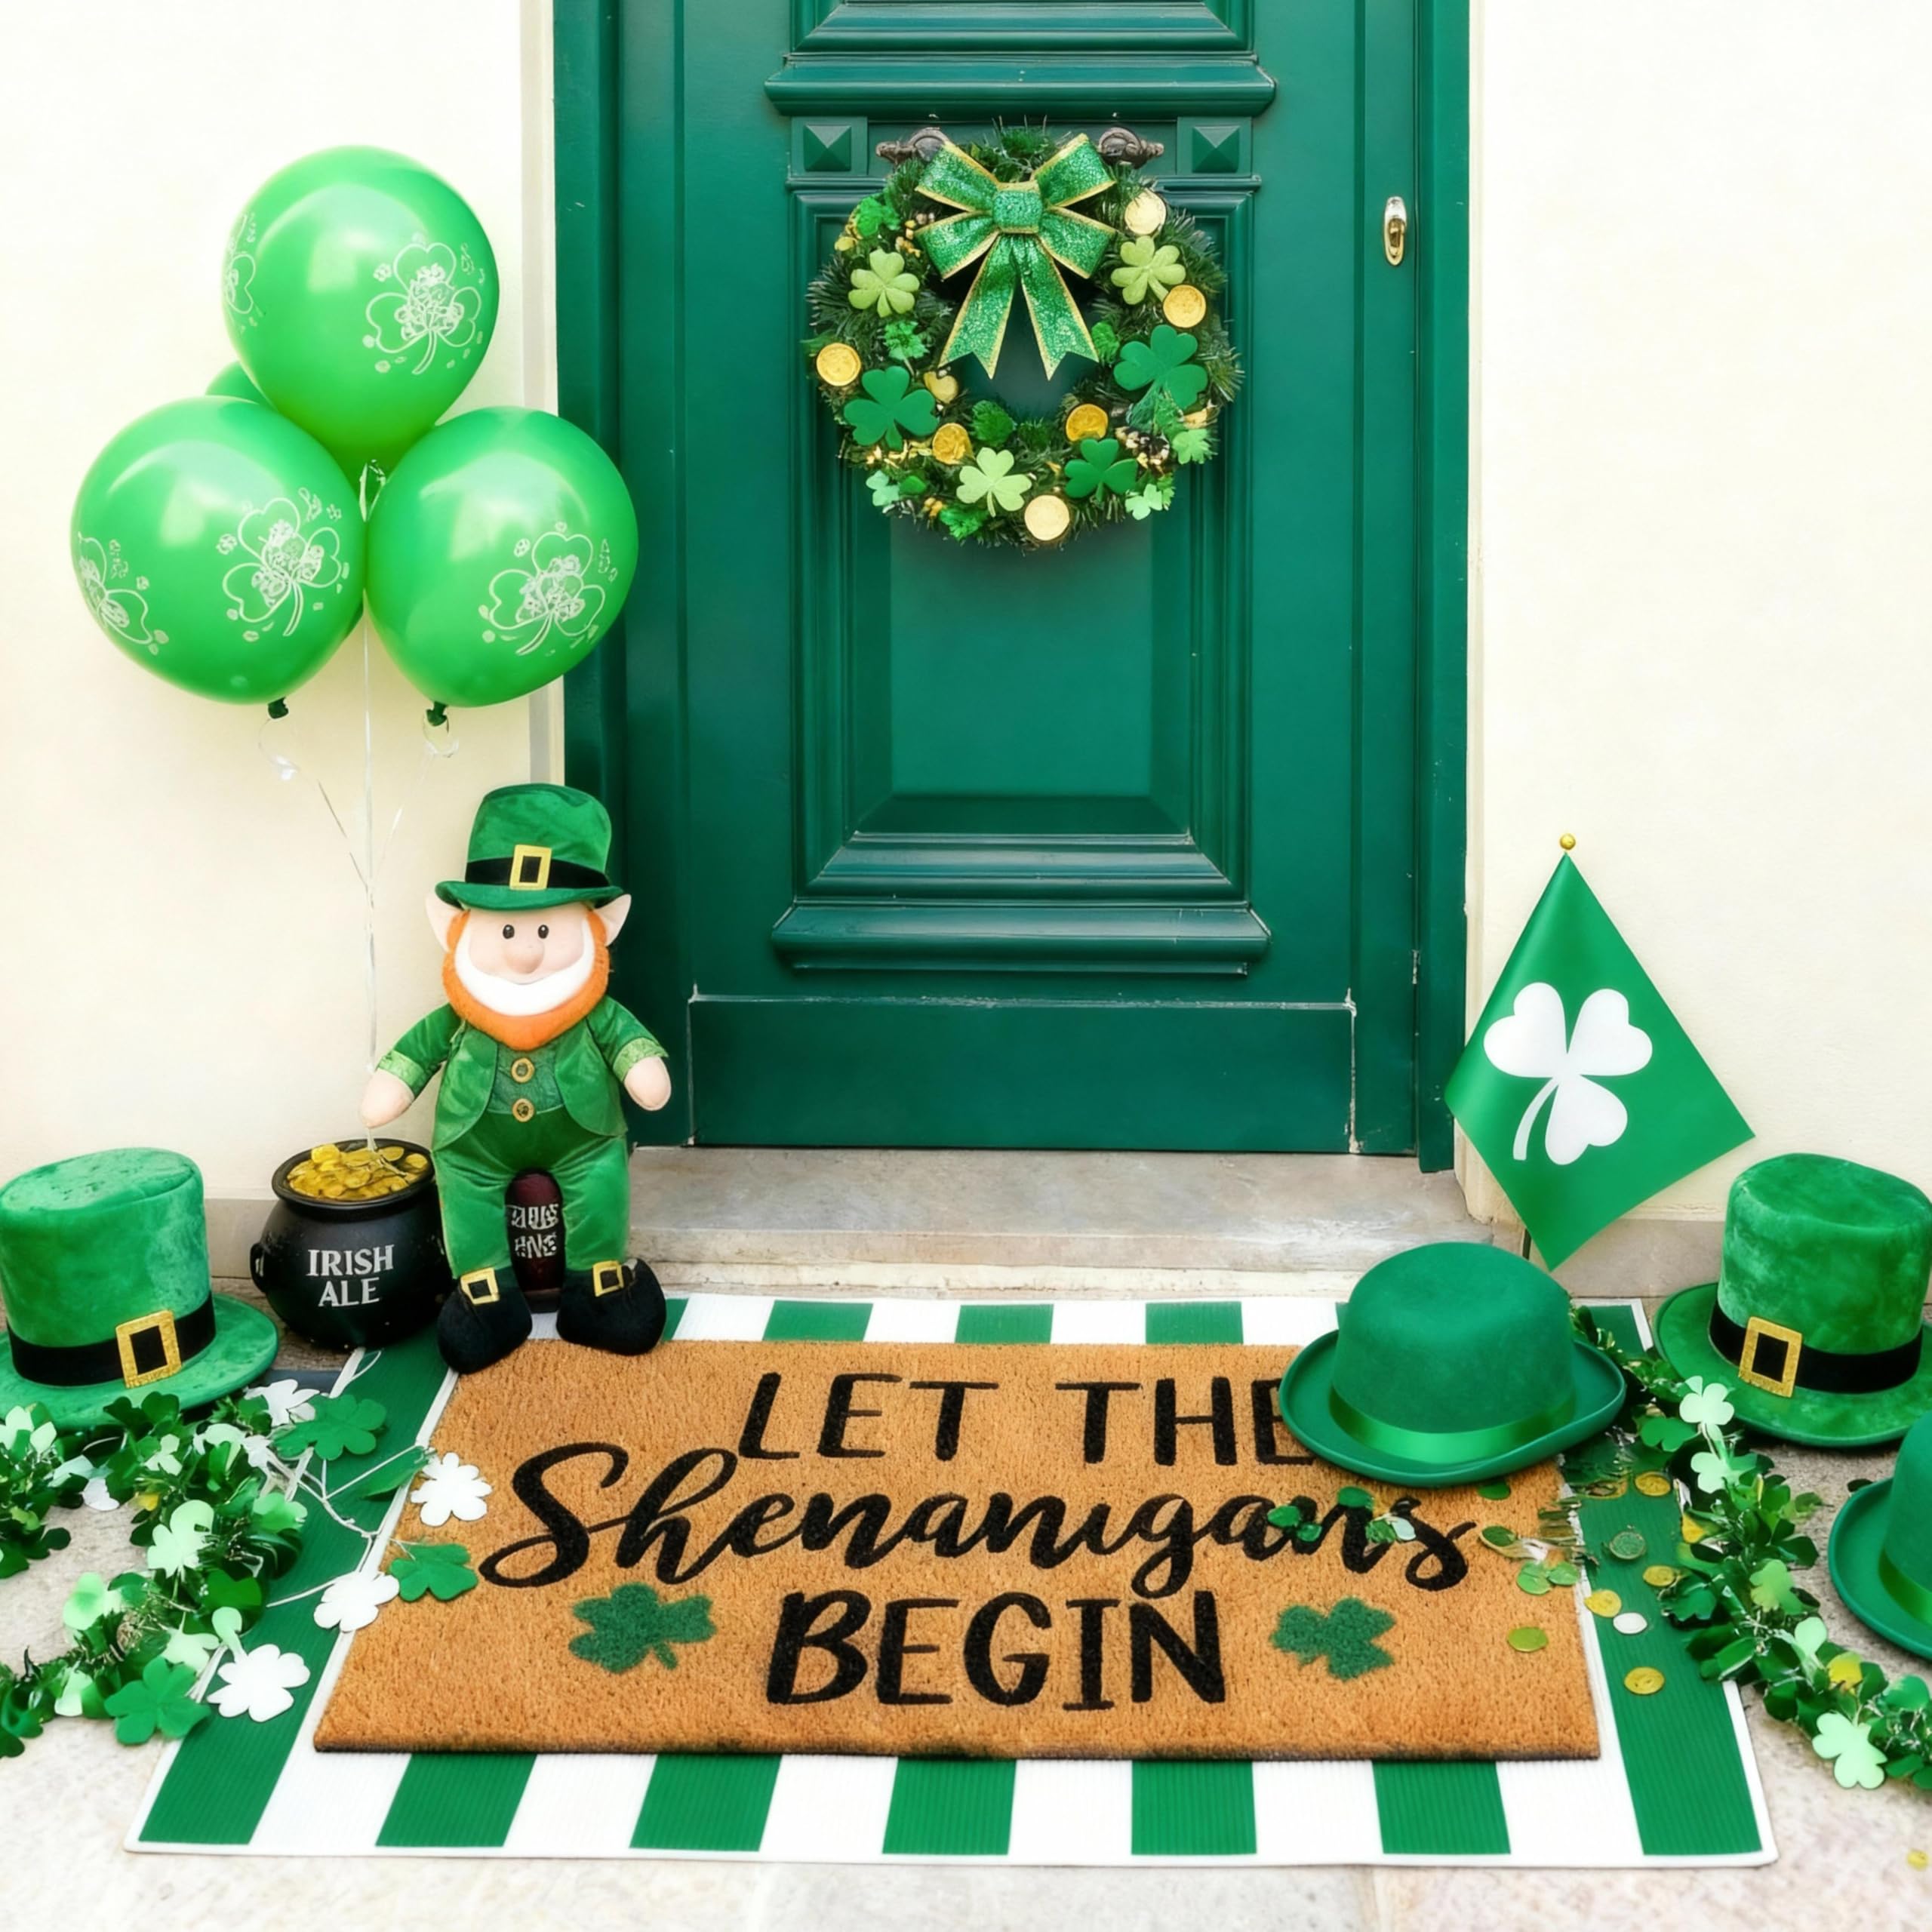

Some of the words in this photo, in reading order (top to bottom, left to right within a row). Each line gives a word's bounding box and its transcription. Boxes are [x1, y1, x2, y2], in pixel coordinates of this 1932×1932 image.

[306, 1244, 395, 1277] IRISH
[318, 1277, 380, 1307] ALE
[739, 1372, 999, 1461] LET
[1056, 1377, 1316, 1466] THE
[479, 1442, 1477, 1600] Shenanigans
[767, 1589, 1226, 1711] BEGIN
